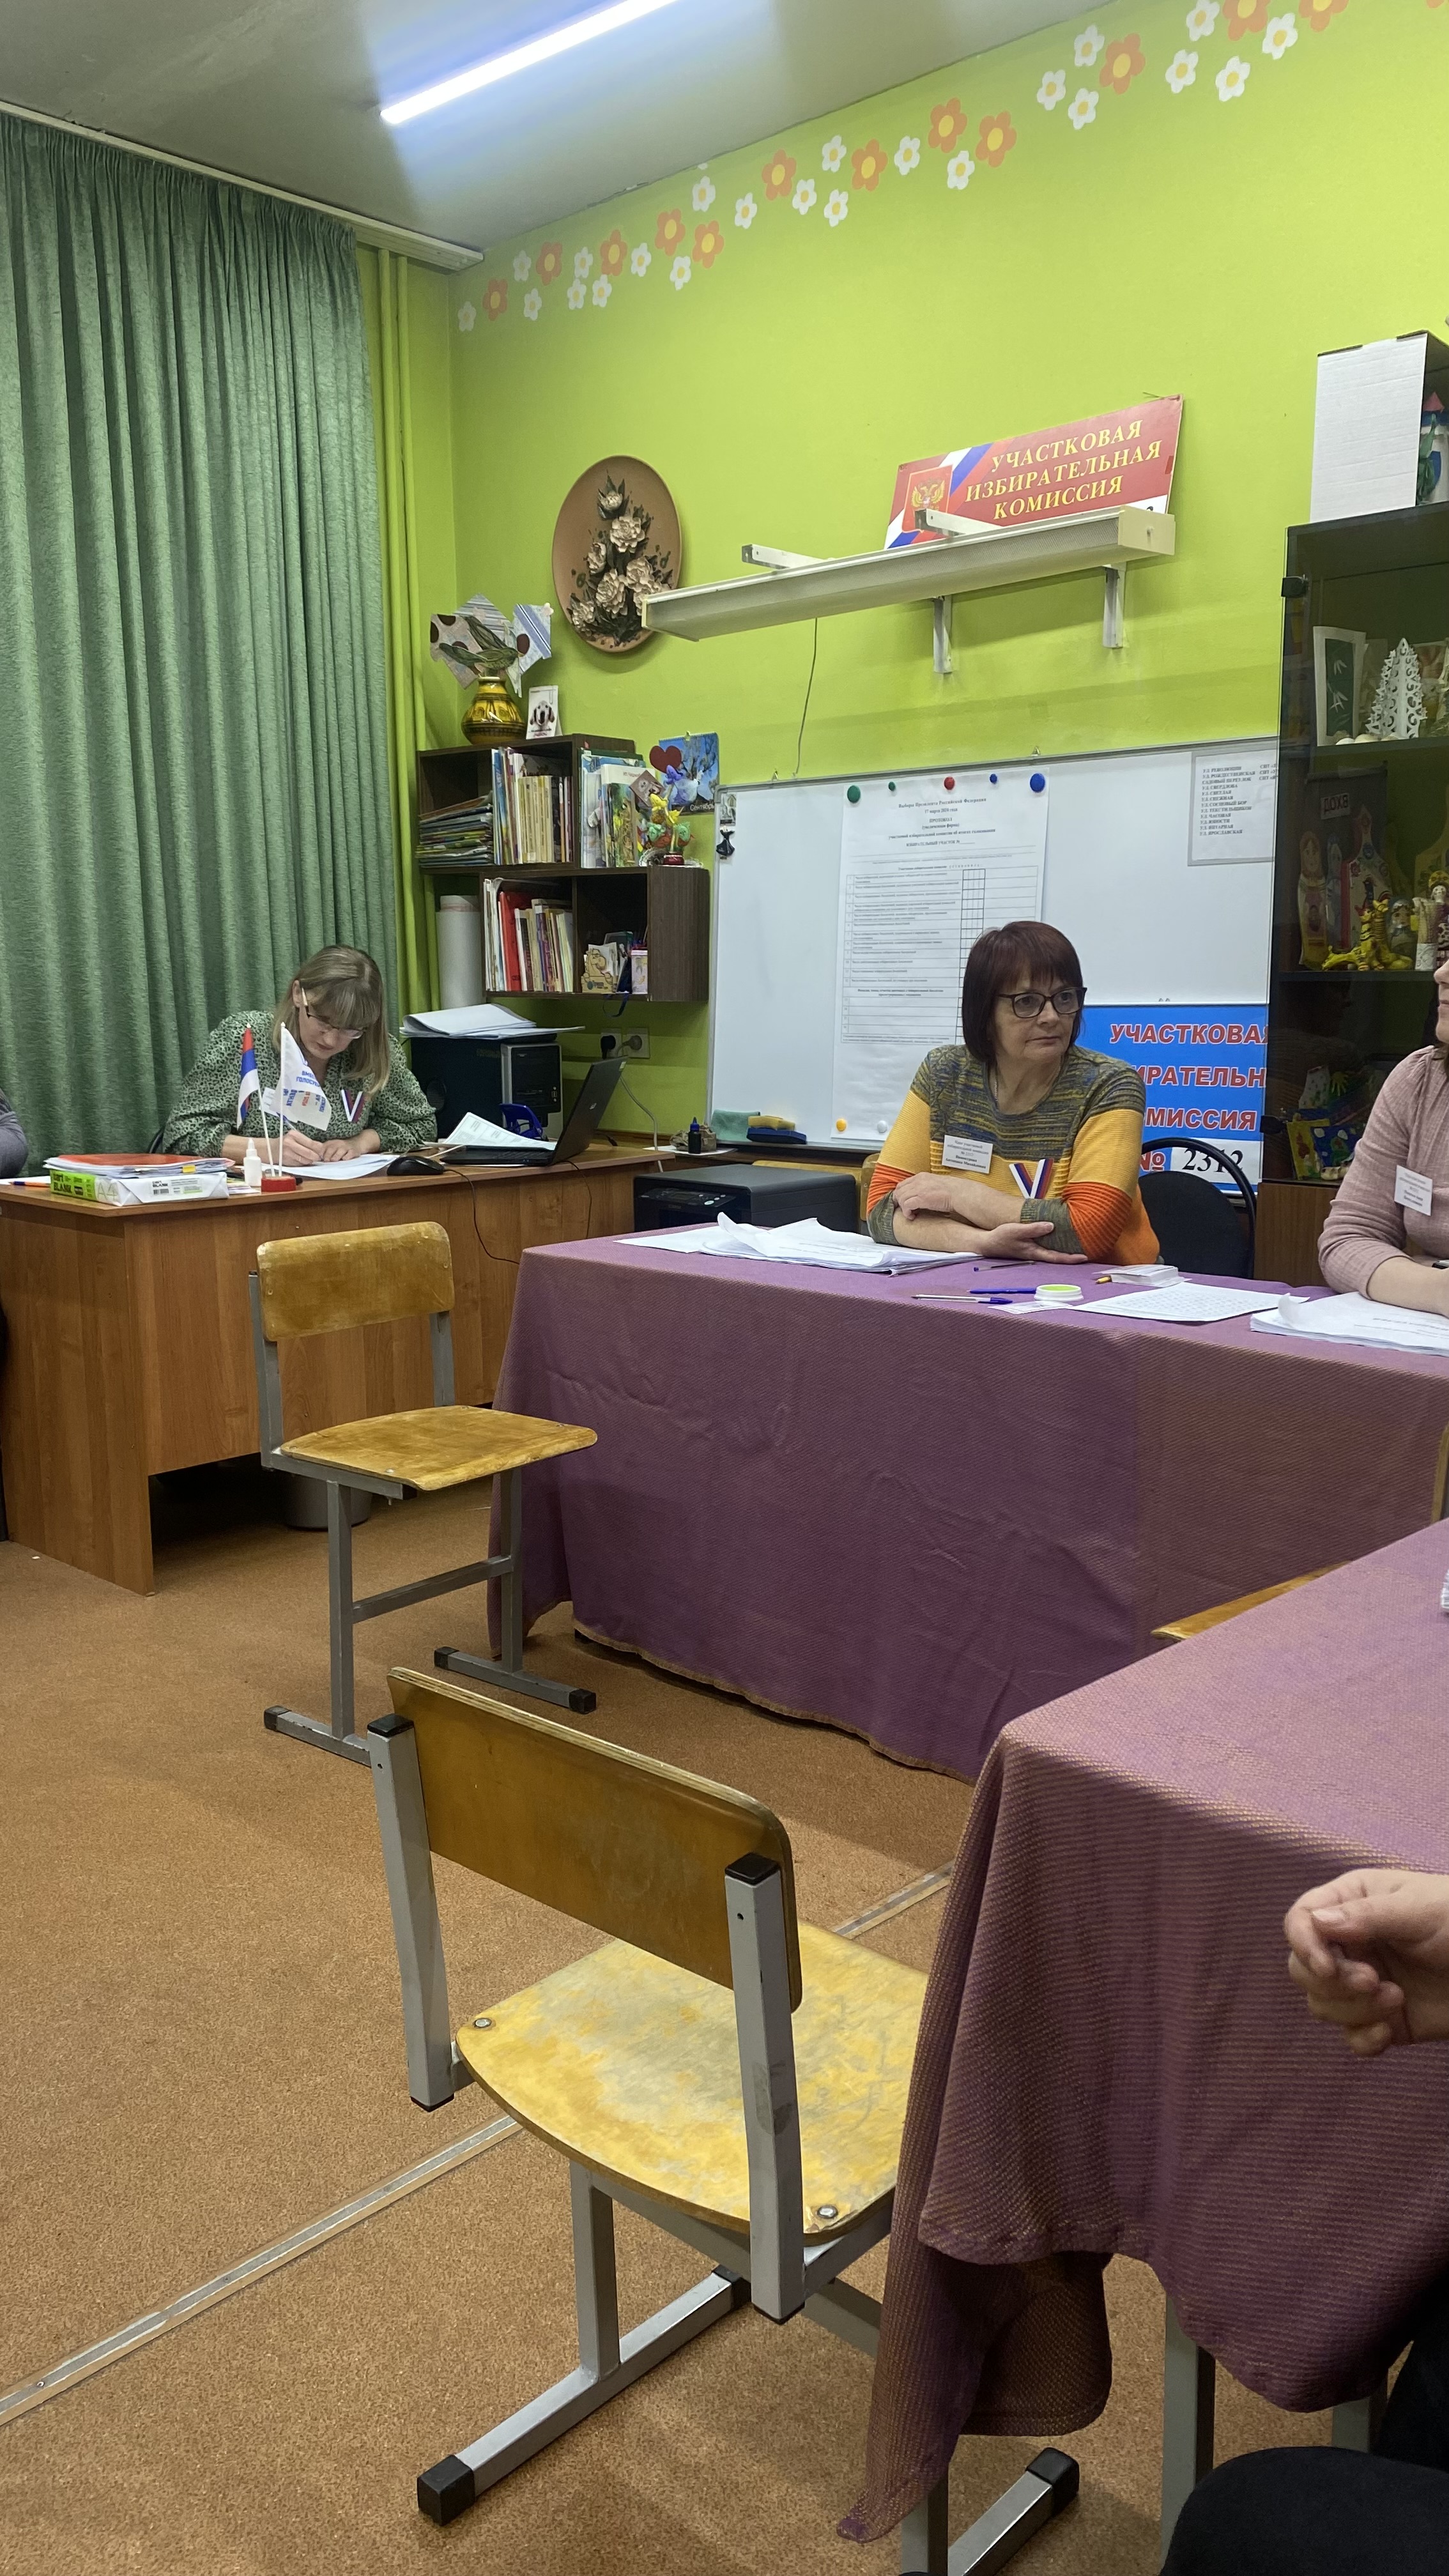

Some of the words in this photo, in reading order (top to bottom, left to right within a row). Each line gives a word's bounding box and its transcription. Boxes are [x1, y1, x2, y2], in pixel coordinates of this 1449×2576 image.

[991, 419, 1142, 473] УЧАСТКОВАЯ
[965, 440, 1162, 503] ИЗБИРАТЕЛЬНАЯ
[993, 475, 1123, 520] КОМИССИЯ
[690, 803, 715, 811] Сентябрь
